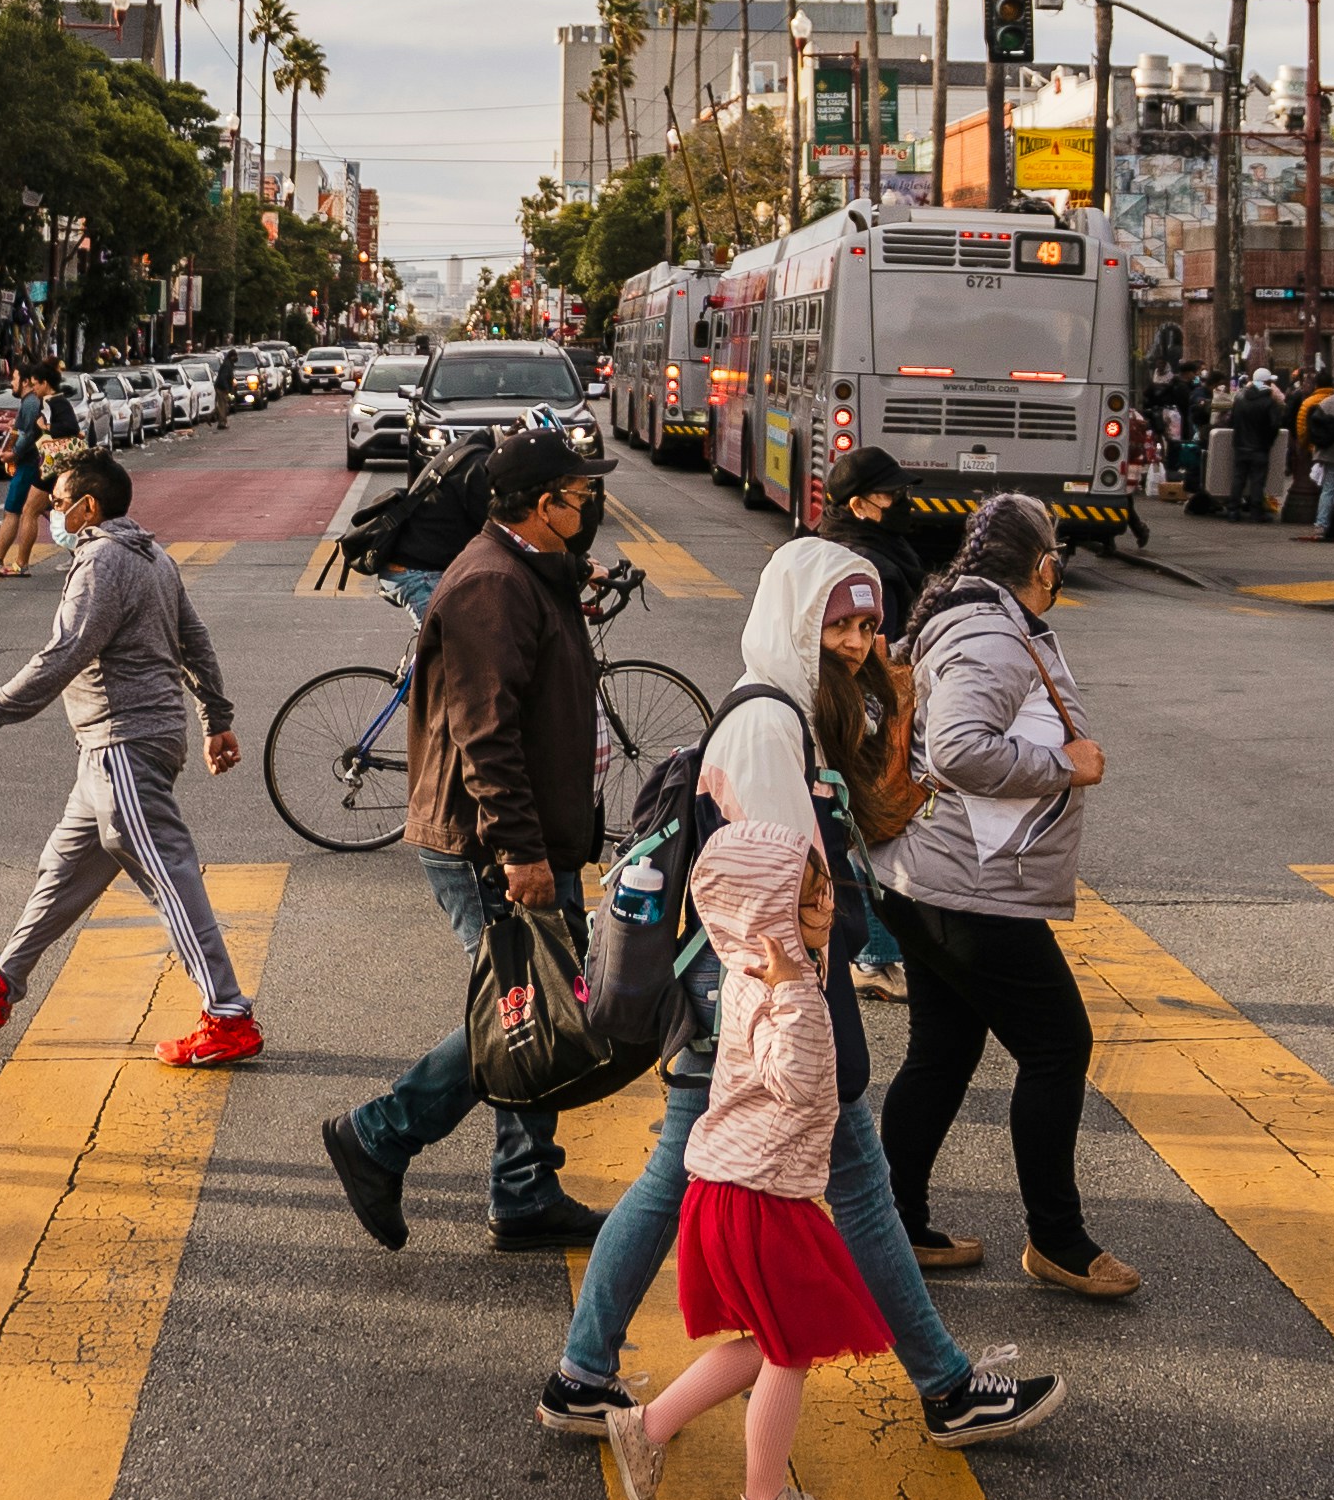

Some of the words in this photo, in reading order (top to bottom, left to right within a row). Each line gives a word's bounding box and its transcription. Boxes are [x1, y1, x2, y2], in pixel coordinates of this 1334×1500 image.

[1036, 240, 1062, 265] 49
[966, 275, 1002, 290] 6721
[942, 381, 1020, 394] www.sfmta.com
